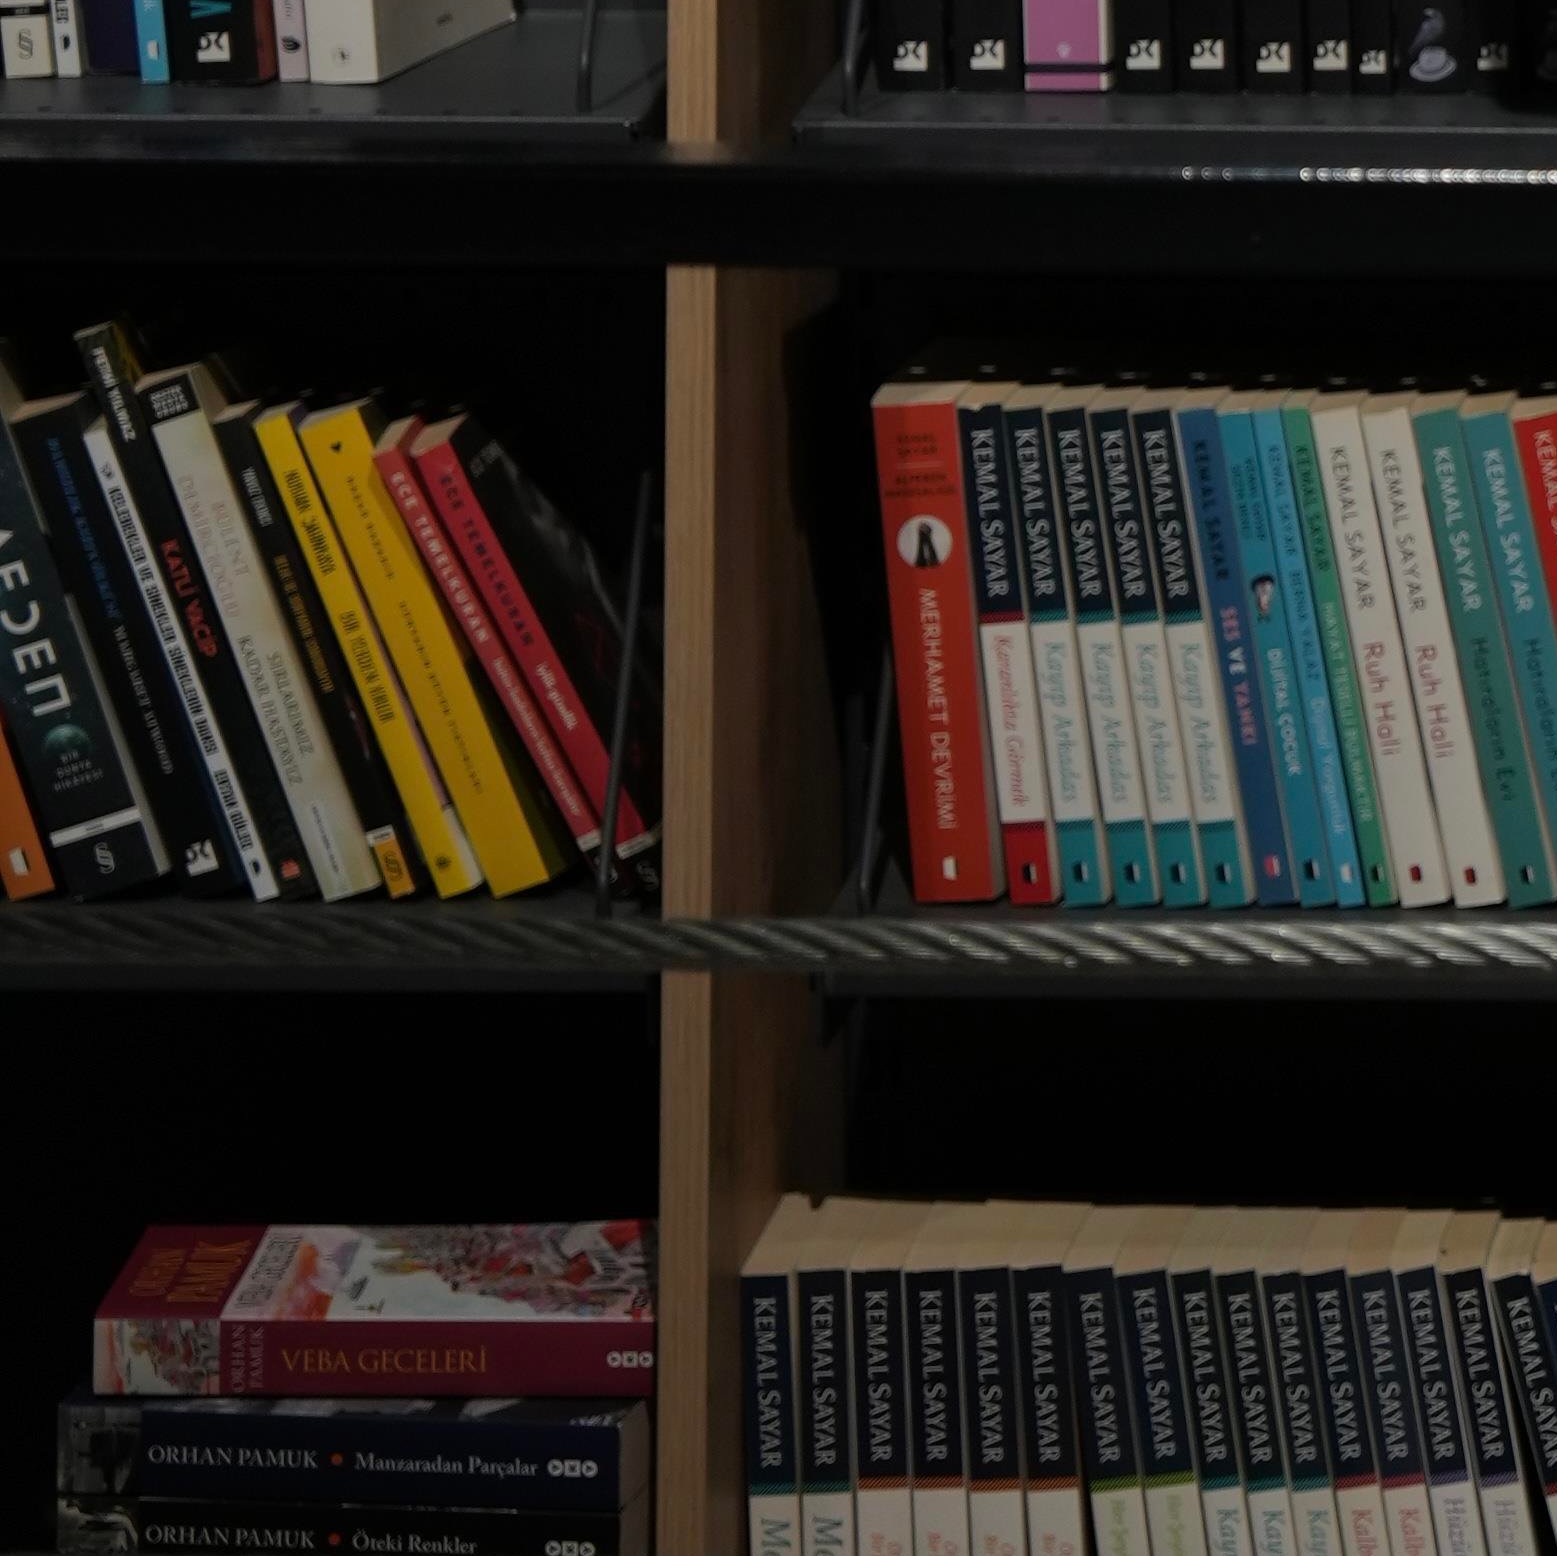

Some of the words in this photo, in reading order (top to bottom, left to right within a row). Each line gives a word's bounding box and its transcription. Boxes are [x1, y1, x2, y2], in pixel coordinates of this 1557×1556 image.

[971, 428, 1001, 520] KEMAL
[981, 522, 1009, 598] SAYAR
[282, 1348, 351, 1373] VEBA
[358, 1345, 487, 1374] GECELERİ
[752, 1296, 777, 1385] KEMAL
[147, 1444, 232, 1467] ORHAN
[239, 1447, 318, 1470] PAMUK
[354, 1450, 462, 1475] Manzaradan
[467, 1455, 538, 1480] Parçalar
[756, 1389, 782, 1469] SAYAR
[351, 1528, 402, 1553] Öteki
[408, 1533, 478, 1555] Renkler
